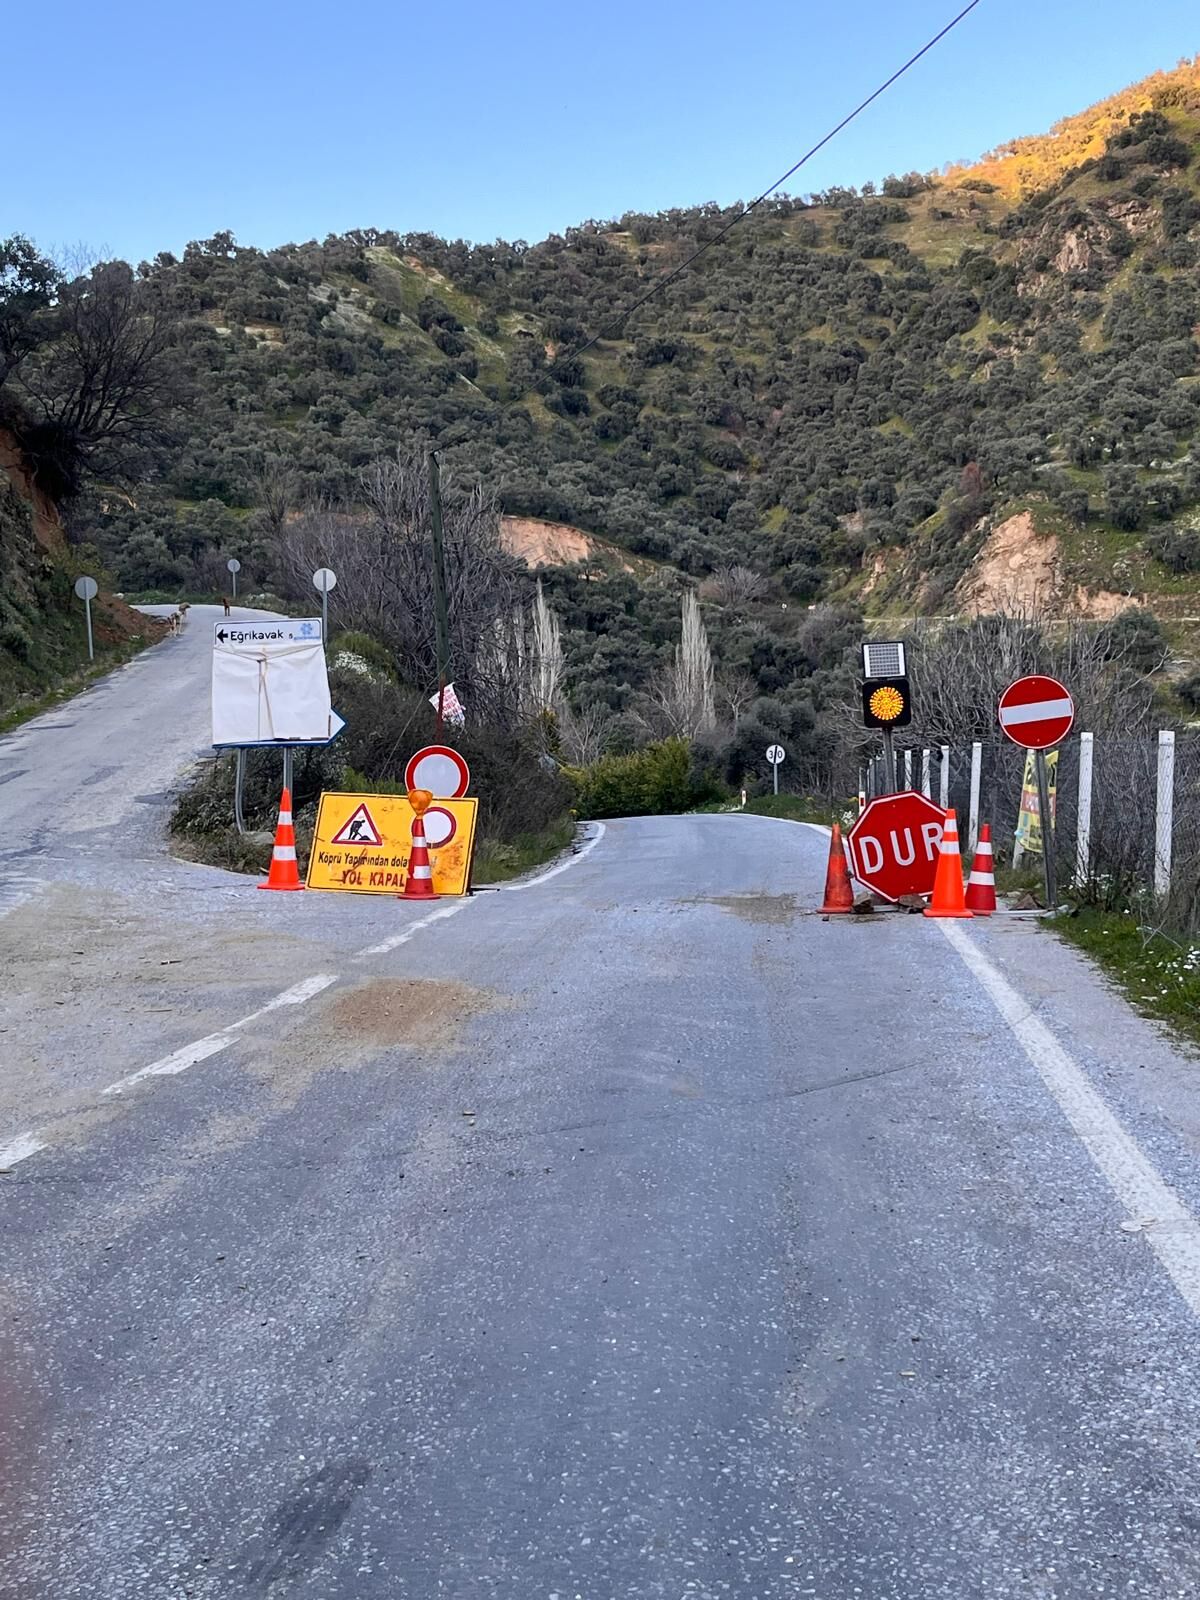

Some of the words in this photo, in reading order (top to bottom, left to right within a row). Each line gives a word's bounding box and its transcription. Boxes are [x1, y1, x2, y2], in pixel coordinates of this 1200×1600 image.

[230, 629, 284, 644] Eğrikavak
[768, 750, 783, 759] 30
[859, 822, 944, 874] DUR
[318, 851, 342, 866] Köprü
[342, 870, 362, 886] YOL
[369, 871, 405, 887] KAPAL
